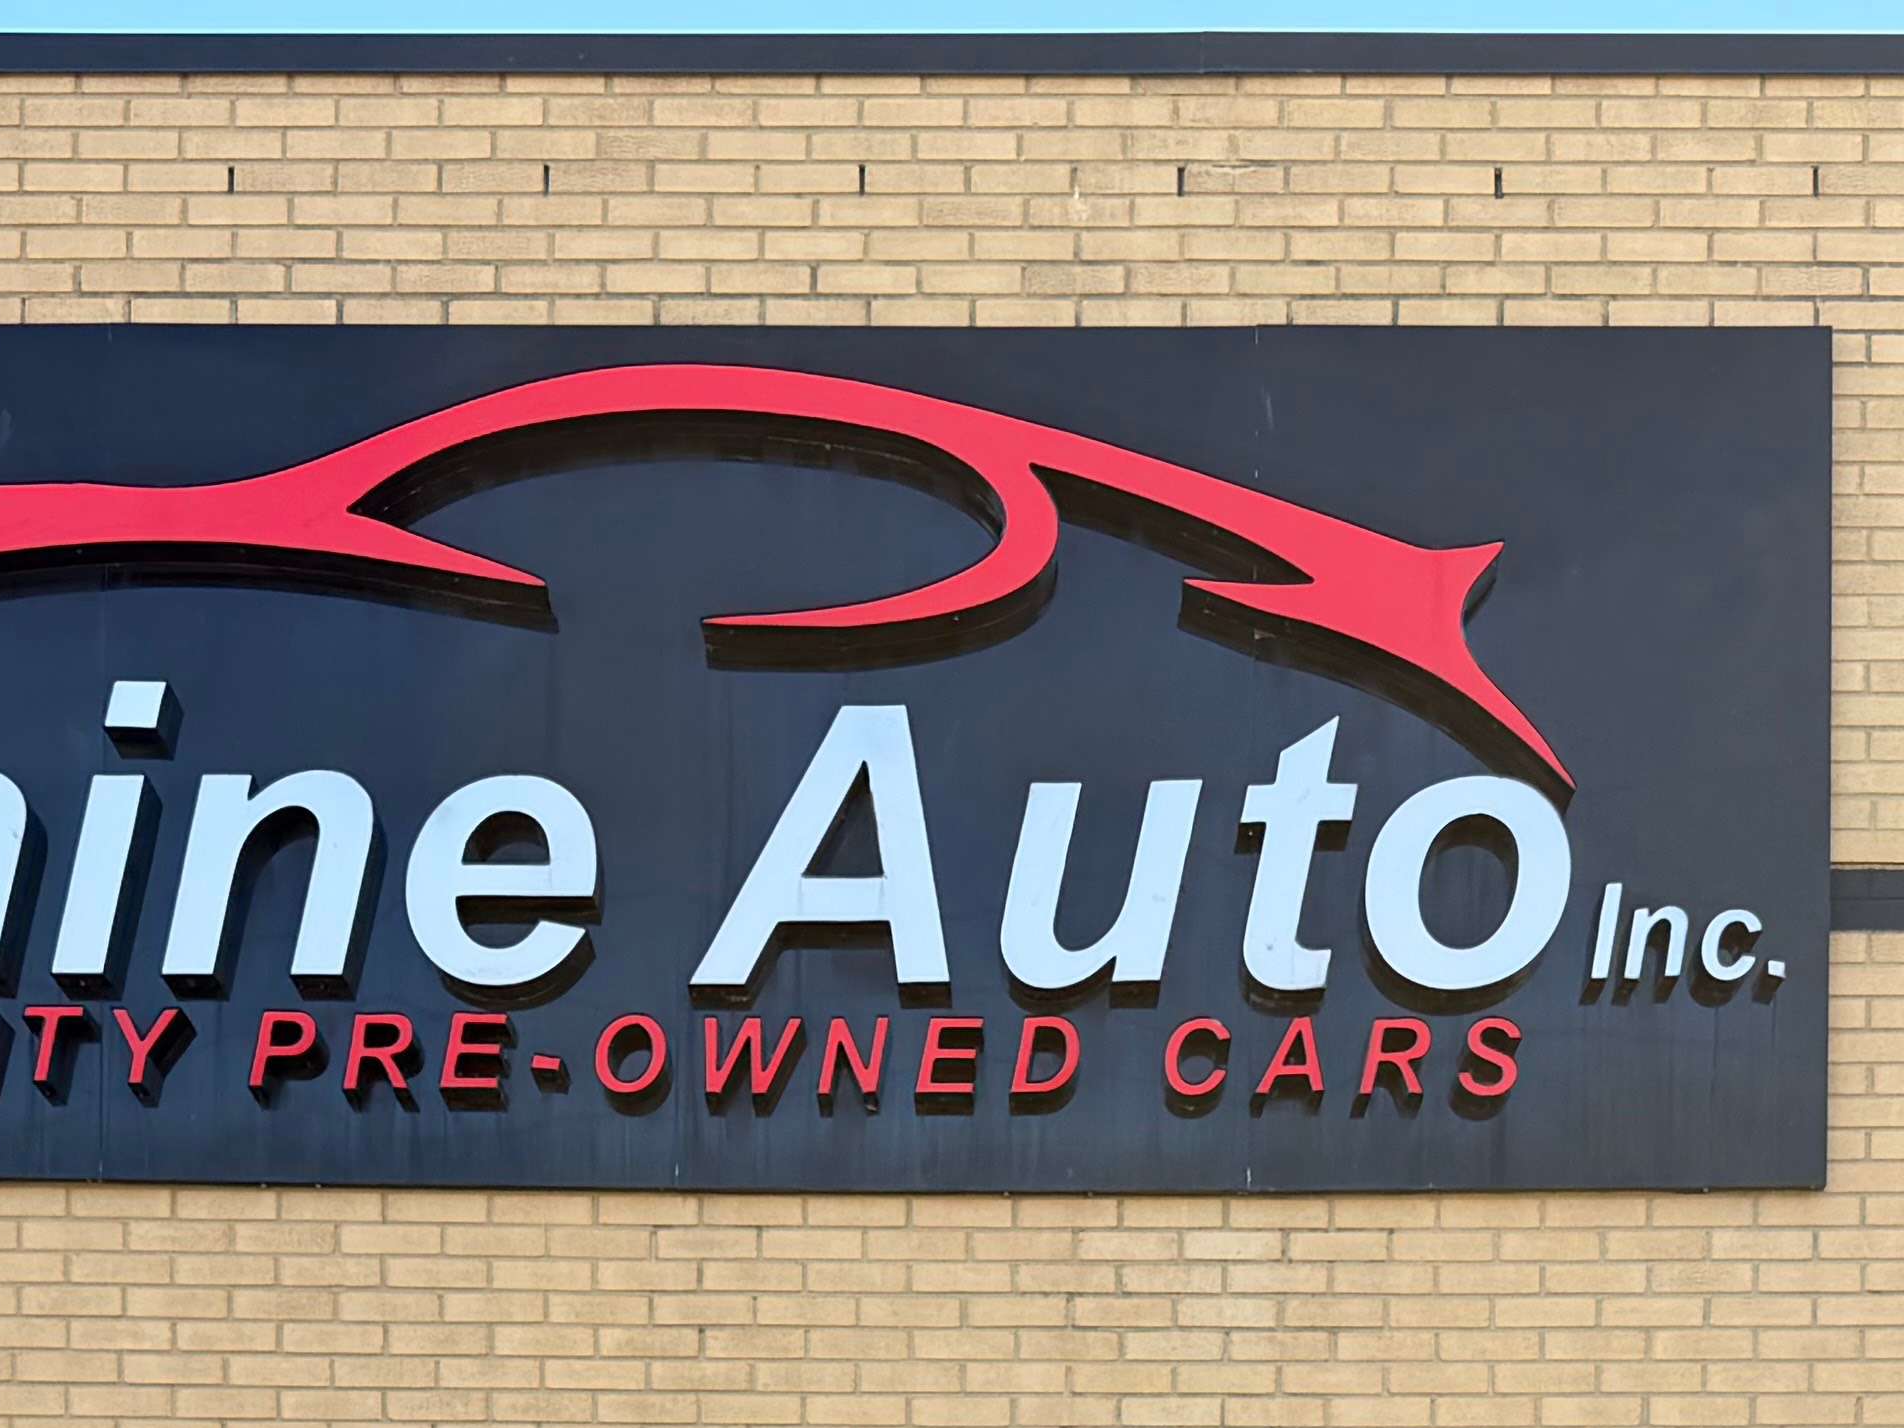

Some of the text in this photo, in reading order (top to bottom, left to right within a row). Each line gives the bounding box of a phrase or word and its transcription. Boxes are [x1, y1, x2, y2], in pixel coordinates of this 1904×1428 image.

[690, 704, 1573, 991] Auto
[1592, 882, 1787, 981] Inc.
[250, 1011, 1081, 1096] PRE-OWNED
[1164, 1017, 1524, 1097] CARS
